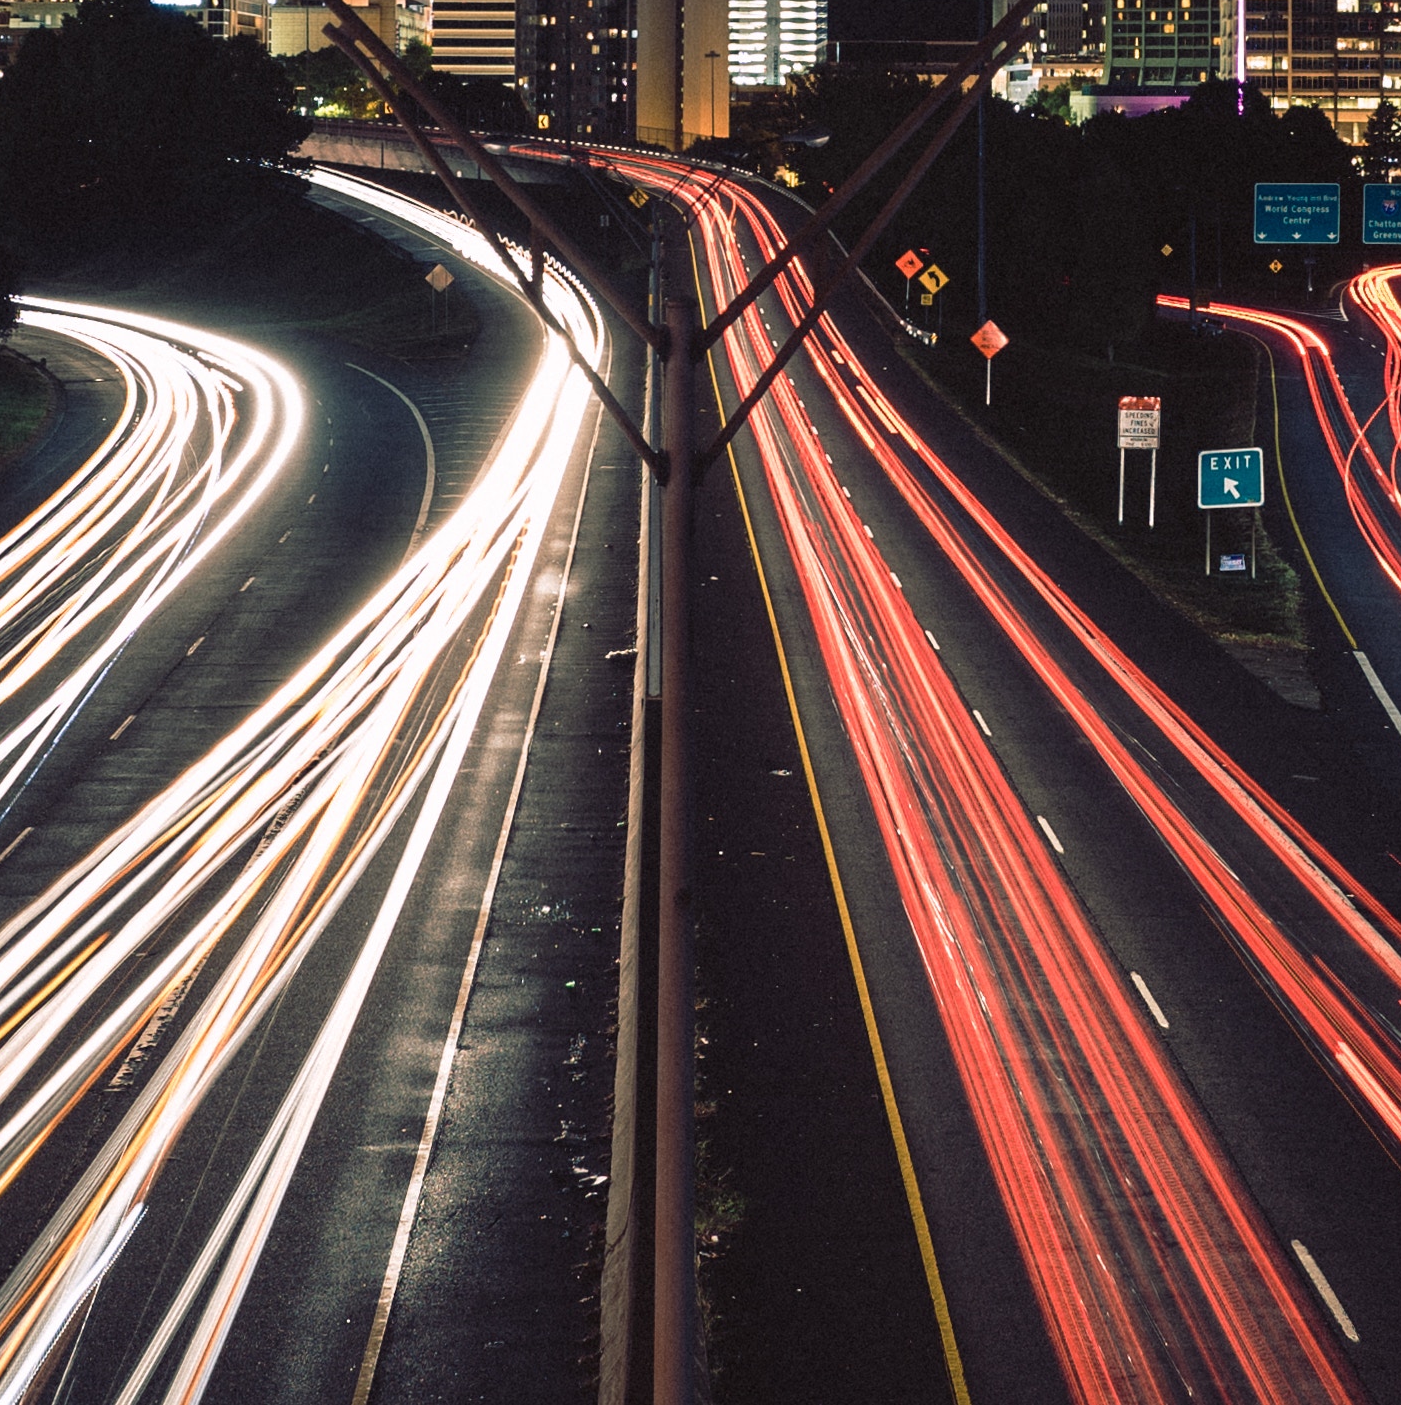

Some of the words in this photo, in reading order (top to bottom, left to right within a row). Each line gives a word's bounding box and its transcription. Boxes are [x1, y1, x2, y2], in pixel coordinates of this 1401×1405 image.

[1265, 205, 1288, 213] World
[1291, 205, 1330, 215] Congress
[1384, 203, 1396, 212] 75
[1283, 216, 1311, 225] Center
[1210, 455, 1251, 471] EXIT
